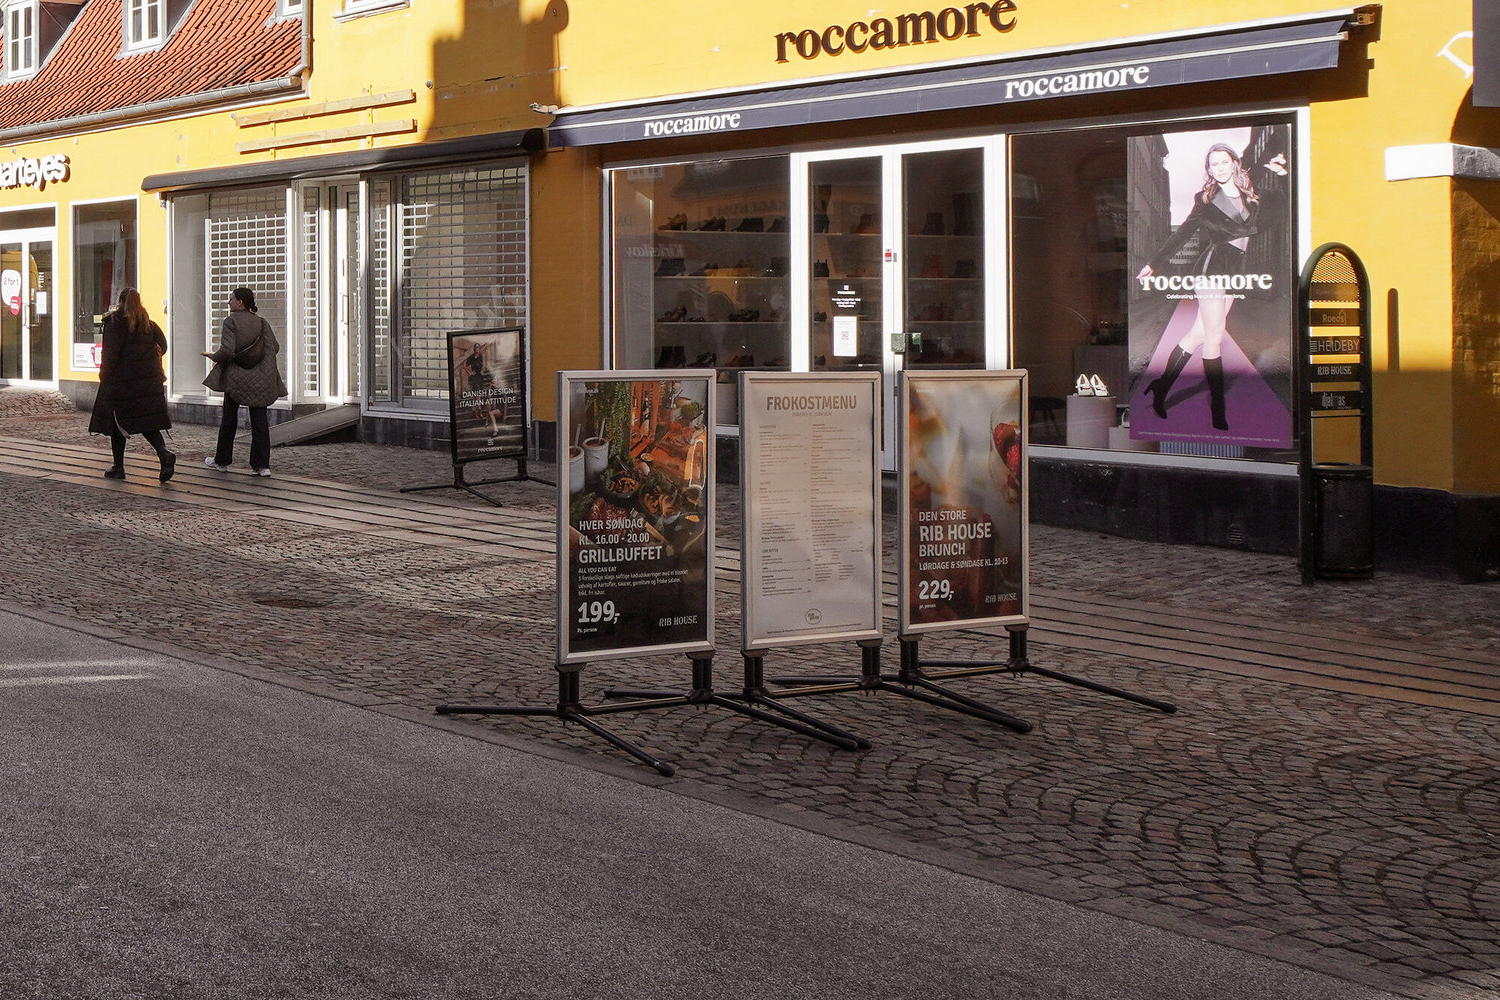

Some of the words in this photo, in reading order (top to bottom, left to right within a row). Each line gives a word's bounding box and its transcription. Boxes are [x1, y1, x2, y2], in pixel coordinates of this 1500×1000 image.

[1004, 64, 1150, 99] roccamore
[643, 113, 741, 137] roccamore
[1142, 273, 1273, 291] roccamore
[1318, 340, 1360, 352] HEIDEBY
[1317, 367, 1329, 375] RIB
[1330, 366, 1352, 375] HOUSE
[462, 390, 486, 398] DANISH
[489, 387, 514, 396] DESIGN
[460, 399, 484, 408] ITALIAN
[485, 396, 516, 405] ATTITUDE
[766, 395, 857, 410] FROKOSTMENU
[919, 512, 937, 521] DEN
[940, 510, 967, 520] STORE
[580, 520, 604, 530] HVER
[605, 518, 644, 529] SØNDAG
[920, 525, 944, 541] RIB
[948, 522, 992, 540] HOUSE
[580, 536, 593, 545] KL.
[596, 534, 619, 544] 16.00
[627, 533, 650, 543] 20.00
[579, 546, 662, 564] GRILLBUFFET
[920, 543, 965, 557] BRUNCH
[920, 561, 949, 570] LØRDAGE
[956, 559, 984, 568] SØNDAGE
[919, 580, 954, 600] 229,-
[985, 595, 996, 603] RIB
[998, 593, 1017, 602] HOUSE
[578, 600, 620, 624] 199,-
[659, 618, 672, 626] RIB
[674, 615, 698, 625] HOUSE
